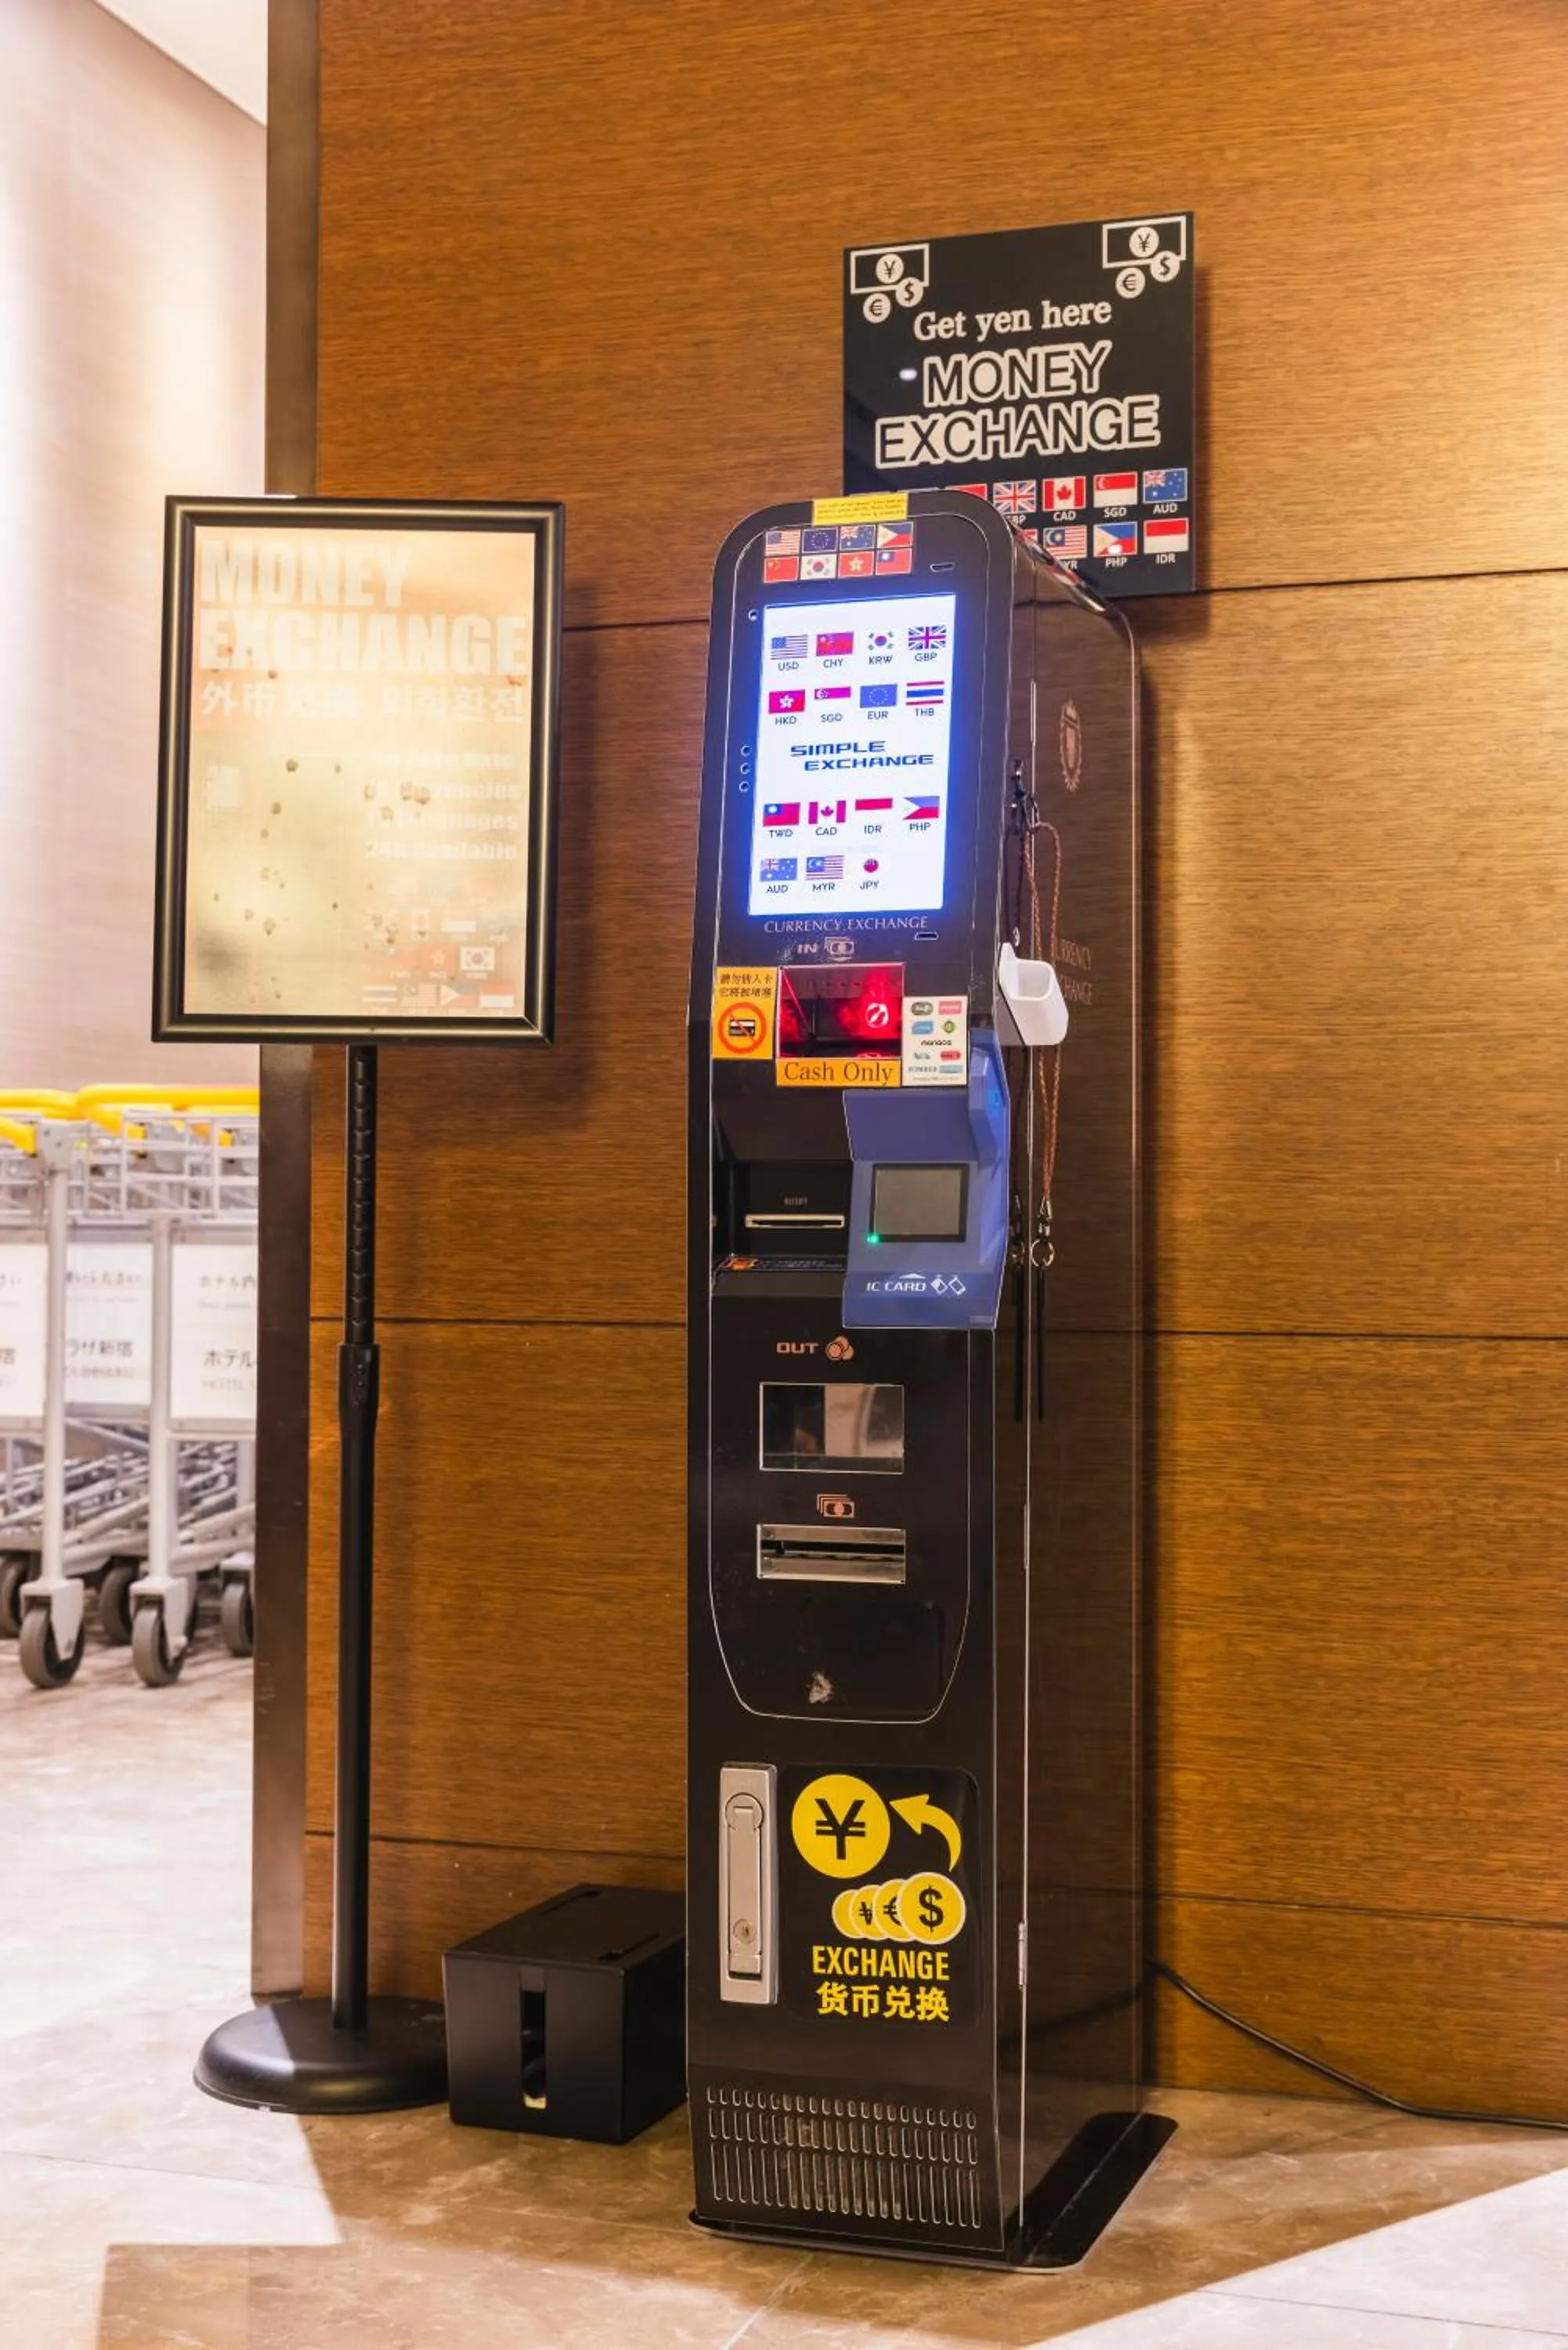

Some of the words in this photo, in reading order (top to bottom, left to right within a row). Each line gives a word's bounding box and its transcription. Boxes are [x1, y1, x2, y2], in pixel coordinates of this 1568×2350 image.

[913, 311, 966, 341] Get
[975, 306, 1032, 342] yen
[1041, 299, 1113, 330] here
[923, 340, 1113, 408] MONEY
[875, 394, 1162, 469] EXCHANGE
[1007, 514, 1027, 525] BP
[1053, 511, 1077, 522] CAD
[1104, 508, 1127, 519] SGD
[1153, 504, 1178, 515] AUD
[1063, 560, 1078, 570] YR
[1105, 557, 1127, 568] PHP
[1156, 554, 1176, 565] IDR
[201, 539, 415, 608] MONEY
[199, 608, 528, 676] EXCHANGE
[778, 662, 800, 671] USD
[822, 659, 844, 668] CHY
[869, 656, 893, 665] KRW
[915, 653, 937, 662] GBP
[775, 716, 797, 725] HKD
[821, 714, 843, 723] SGD
[867, 710, 889, 720] EUR
[915, 707, 934, 717] THB
[790, 740, 886, 757] SIMPLE
[804, 754, 934, 772] EXCHANGE
[768, 829, 793, 838] TWD
[815, 826, 838, 837] CAD
[864, 825, 882, 834] IDR
[909, 822, 931, 832] PHP
[765, 884, 789, 894] AUD
[812, 882, 836, 891] MYR
[859, 880, 880, 890] JPY
[764, 919, 841, 933] CURRENCY
[847, 916, 928, 931] EXCHANGE
[797, 942, 818, 954] IN
[784, 1061, 835, 1081] Cash
[843, 1061, 894, 1086] Only
[866, 1282, 882, 1292] IC
[884, 1281, 927, 1292] CARD
[776, 1342, 818, 1354] OUT
[203, 1350, 257, 1368] ホテル
[812, 1944, 950, 1981] EXCHANGE
[816, 1982, 950, 2022] 货币兑换
